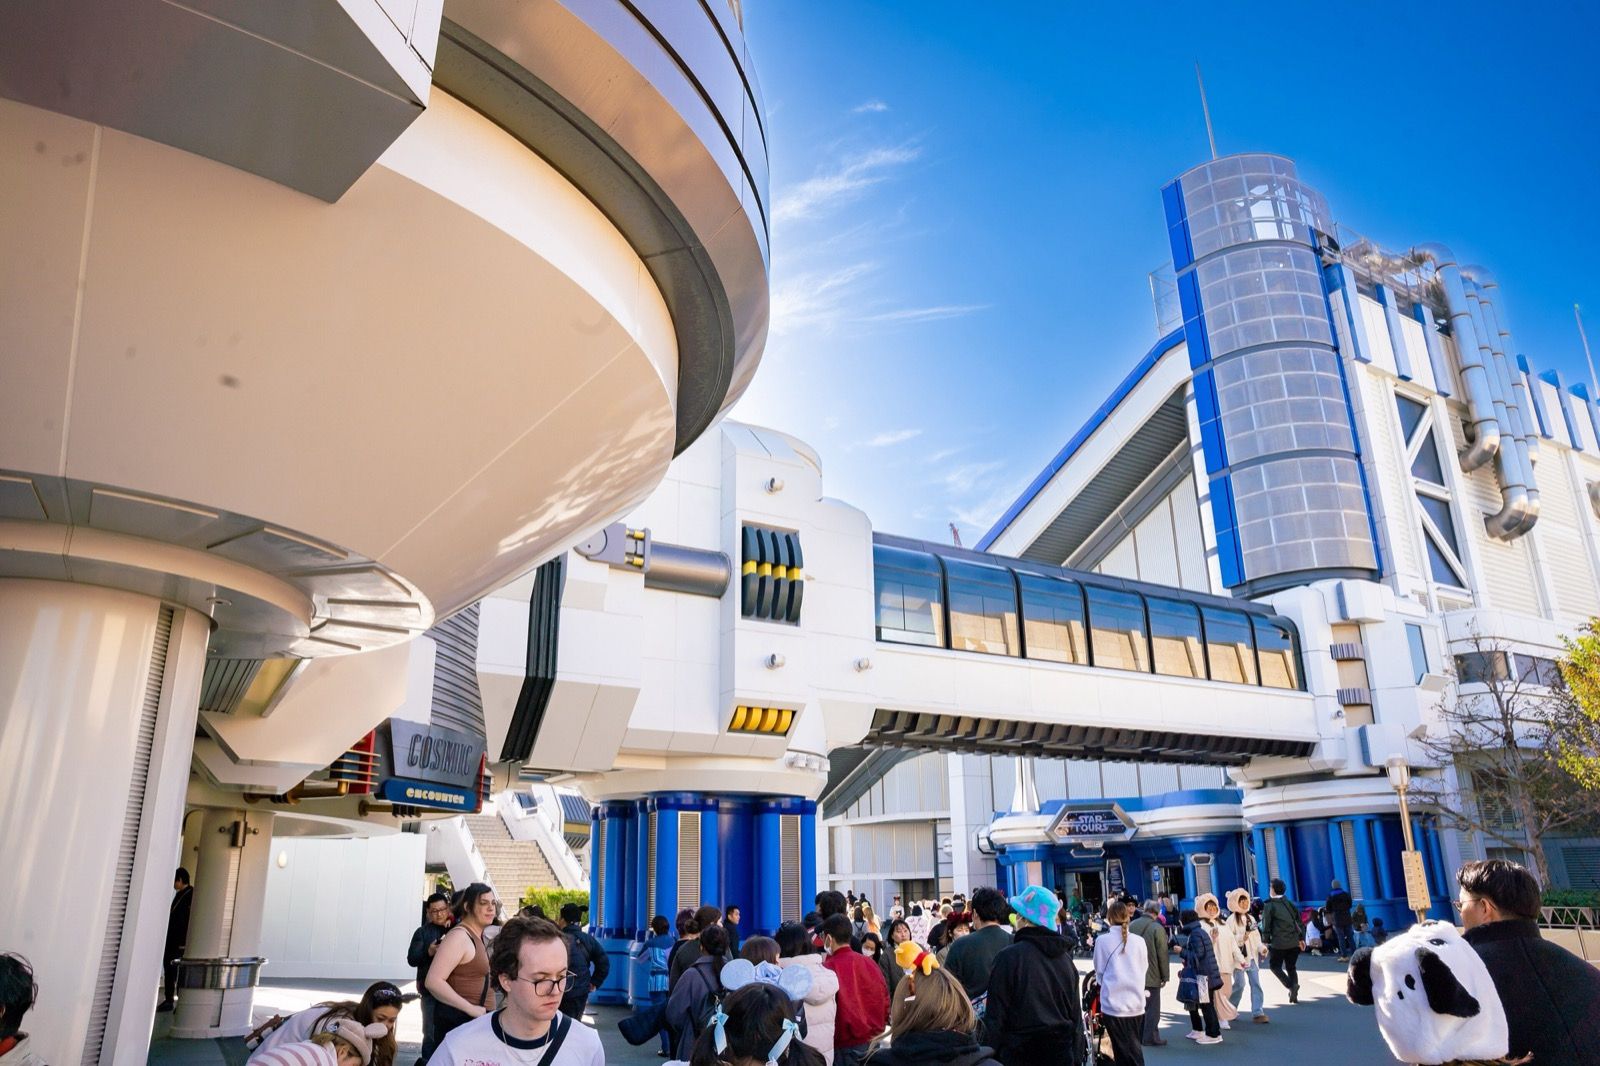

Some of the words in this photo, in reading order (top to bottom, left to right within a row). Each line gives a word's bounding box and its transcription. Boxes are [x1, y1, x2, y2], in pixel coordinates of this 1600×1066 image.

[407, 733, 473, 776] COSMIC
[1078, 815, 1103, 823] STAR
[1074, 823, 1109, 832] TOURS
